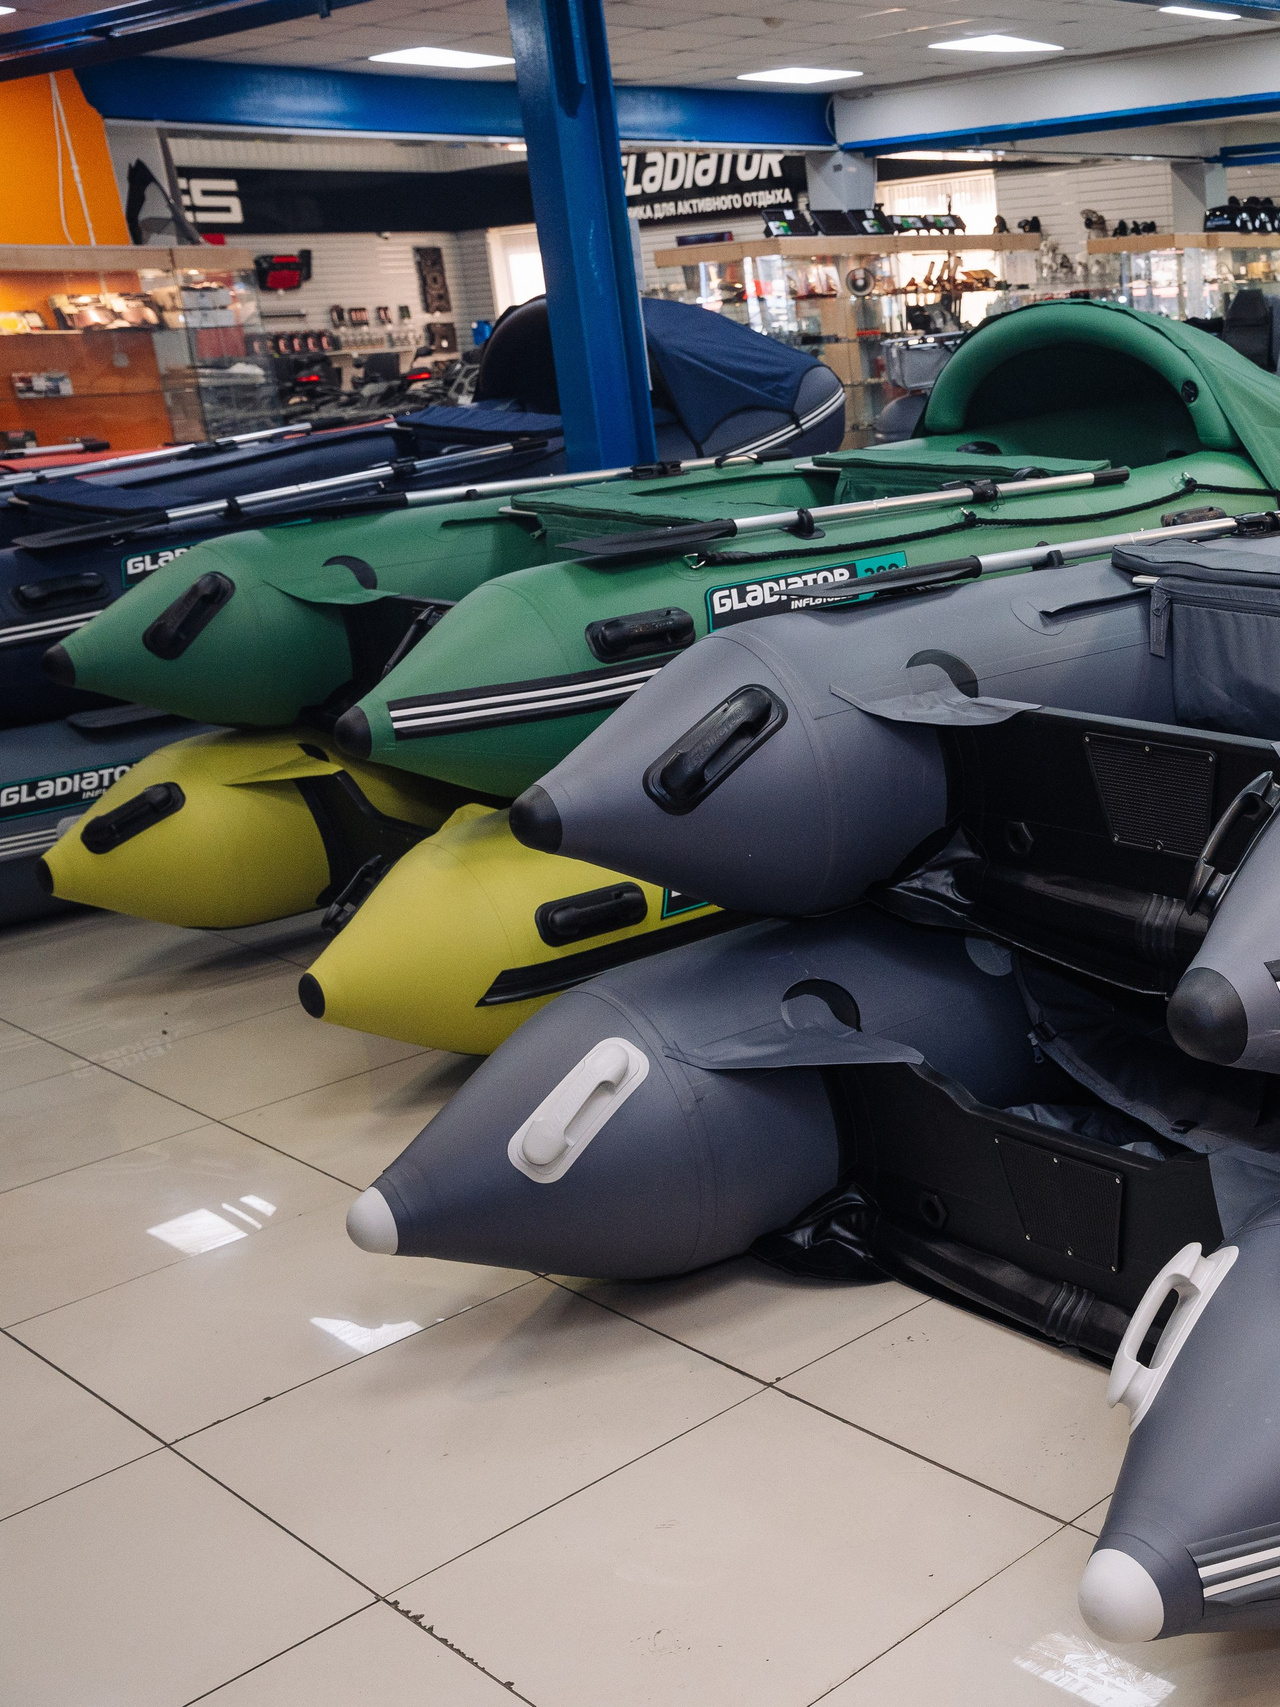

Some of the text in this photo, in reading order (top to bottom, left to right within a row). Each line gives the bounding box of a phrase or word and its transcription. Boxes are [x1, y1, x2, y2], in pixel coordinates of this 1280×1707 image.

[677, 193, 741, 216] АКТИВНОГО
[743, 187, 793, 208] ОТДЫХА
[1, 764, 136, 807] GLADIATO
